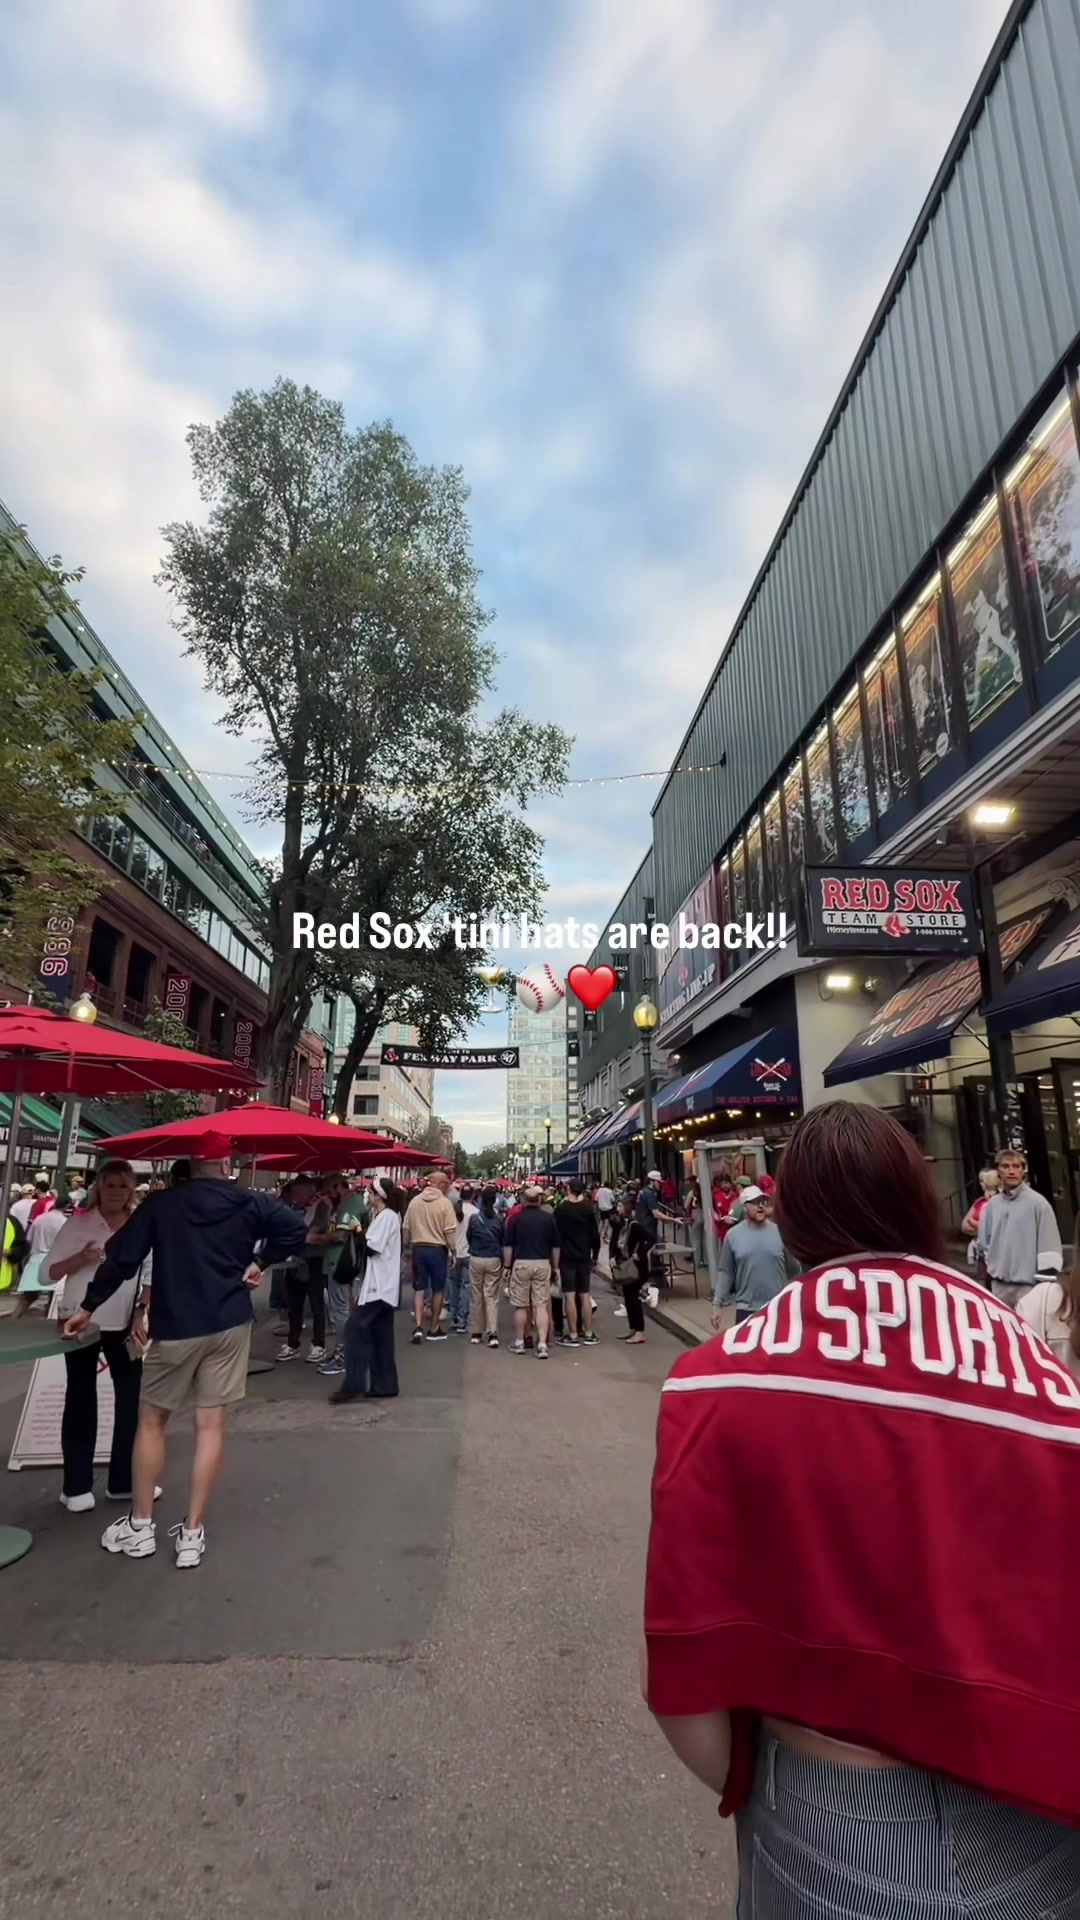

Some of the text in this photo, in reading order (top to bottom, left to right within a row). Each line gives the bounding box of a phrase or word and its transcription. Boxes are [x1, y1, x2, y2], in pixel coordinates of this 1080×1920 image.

[821, 877, 963, 912] RED SOX
[827, 913, 960, 926] TEAM STORE
[41, 915, 74, 976] 986
[460, 1054, 498, 1063] PARK
[721, 1266, 1080, 1409] GO SPORTS
